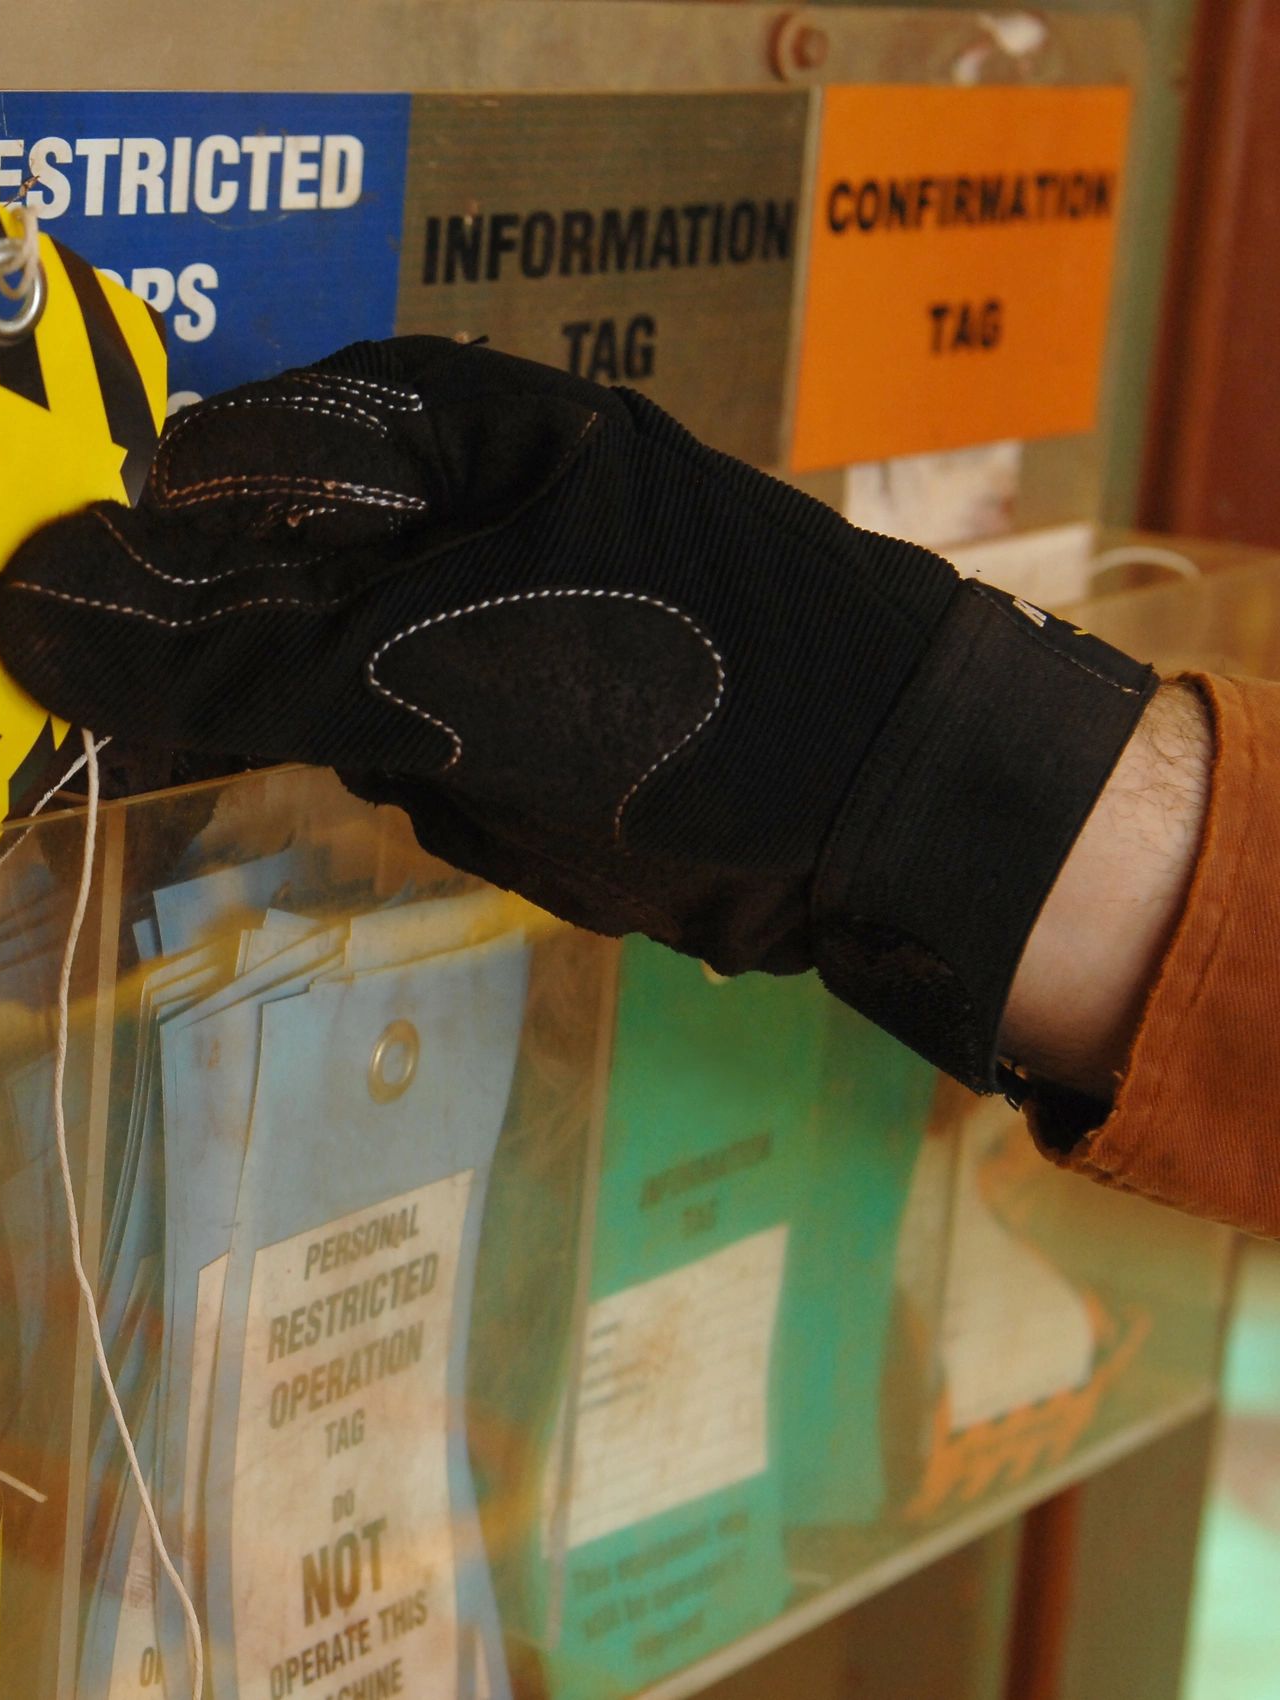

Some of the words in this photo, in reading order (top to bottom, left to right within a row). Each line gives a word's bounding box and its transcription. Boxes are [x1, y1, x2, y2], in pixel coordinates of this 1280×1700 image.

[828, 171, 1117, 234] CONFIRMATION
[421, 199, 798, 286] INFORMATION
[98, 262, 219, 343] PS
[930, 297, 1003, 356] TAG
[561, 313, 658, 384] TAG
[304, 1203, 419, 1281] PERSONAL
[267, 1252, 439, 1364] RESTRICTED
[270, 1320, 425, 1430] OPERATION
[324, 1407, 365, 1459] TAG
[332, 1488, 355, 1523] DO
[302, 1517, 387, 1627] NOT
[270, 1618, 371, 1700] OPERATE
[378, 1588, 428, 1644] THIS
